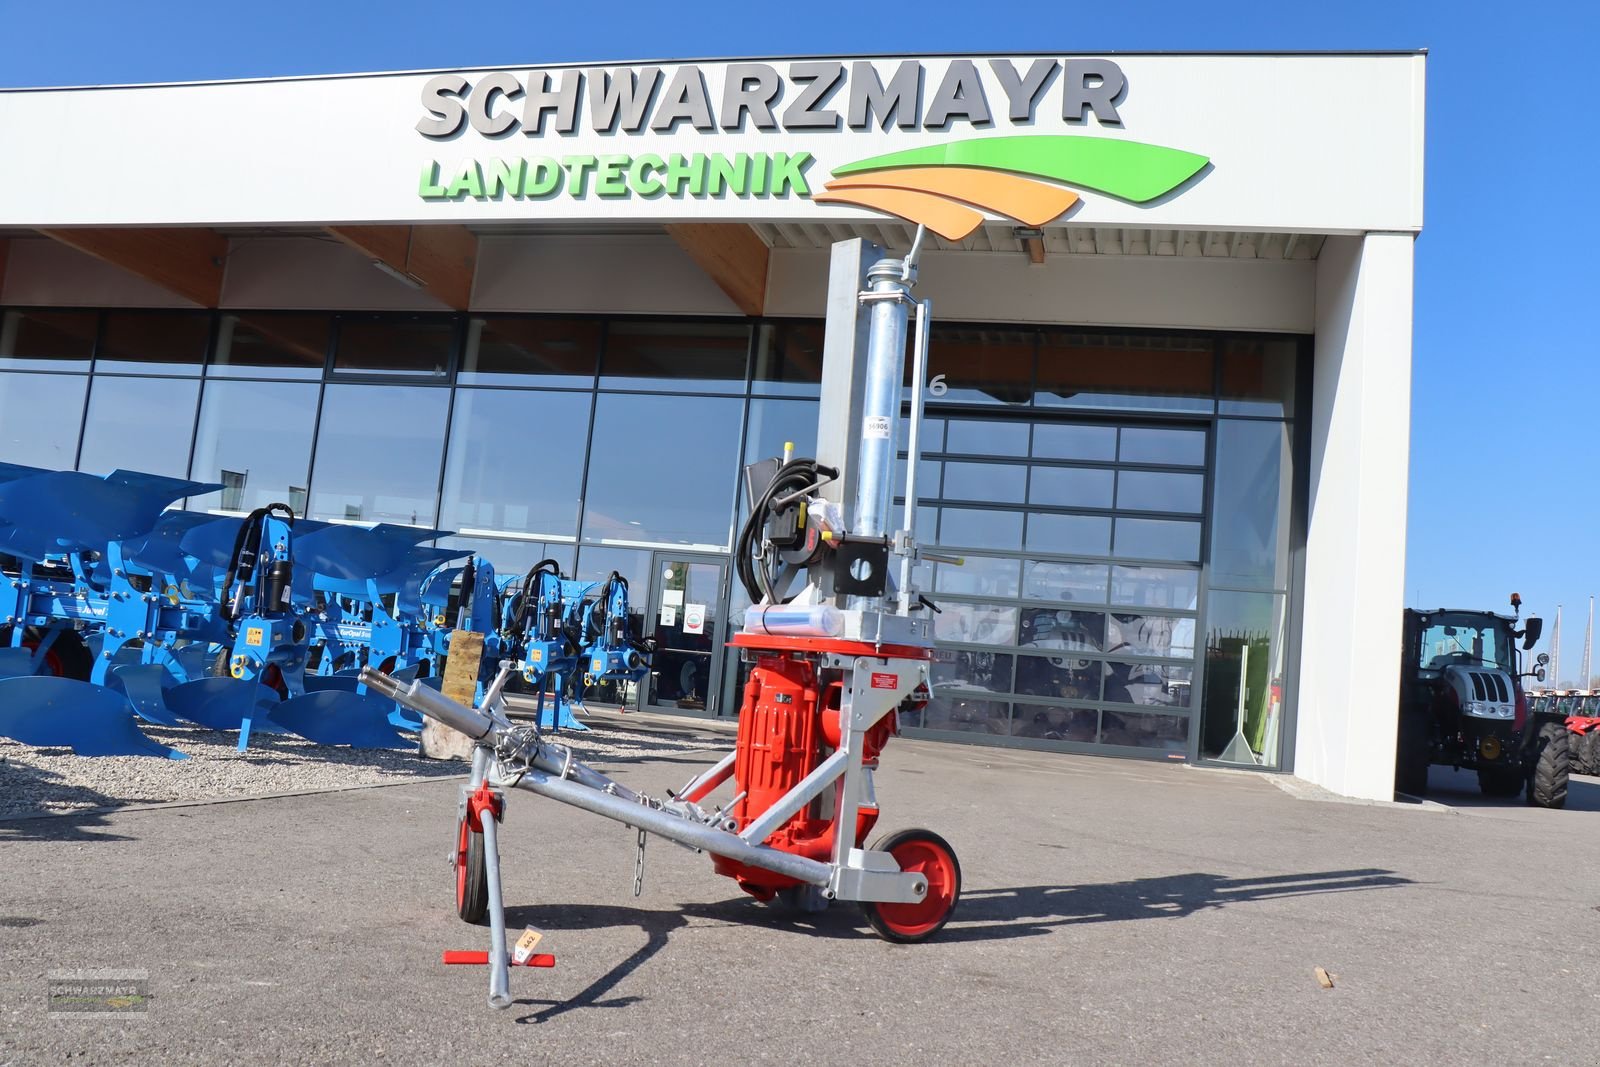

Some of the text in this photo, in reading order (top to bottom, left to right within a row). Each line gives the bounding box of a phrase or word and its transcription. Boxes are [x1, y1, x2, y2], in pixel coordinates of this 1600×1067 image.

[415, 58, 1125, 137] SCHWARZMAYR
[418, 152, 813, 199] LANDTECHNIK
[929, 374, 948, 396] 6
